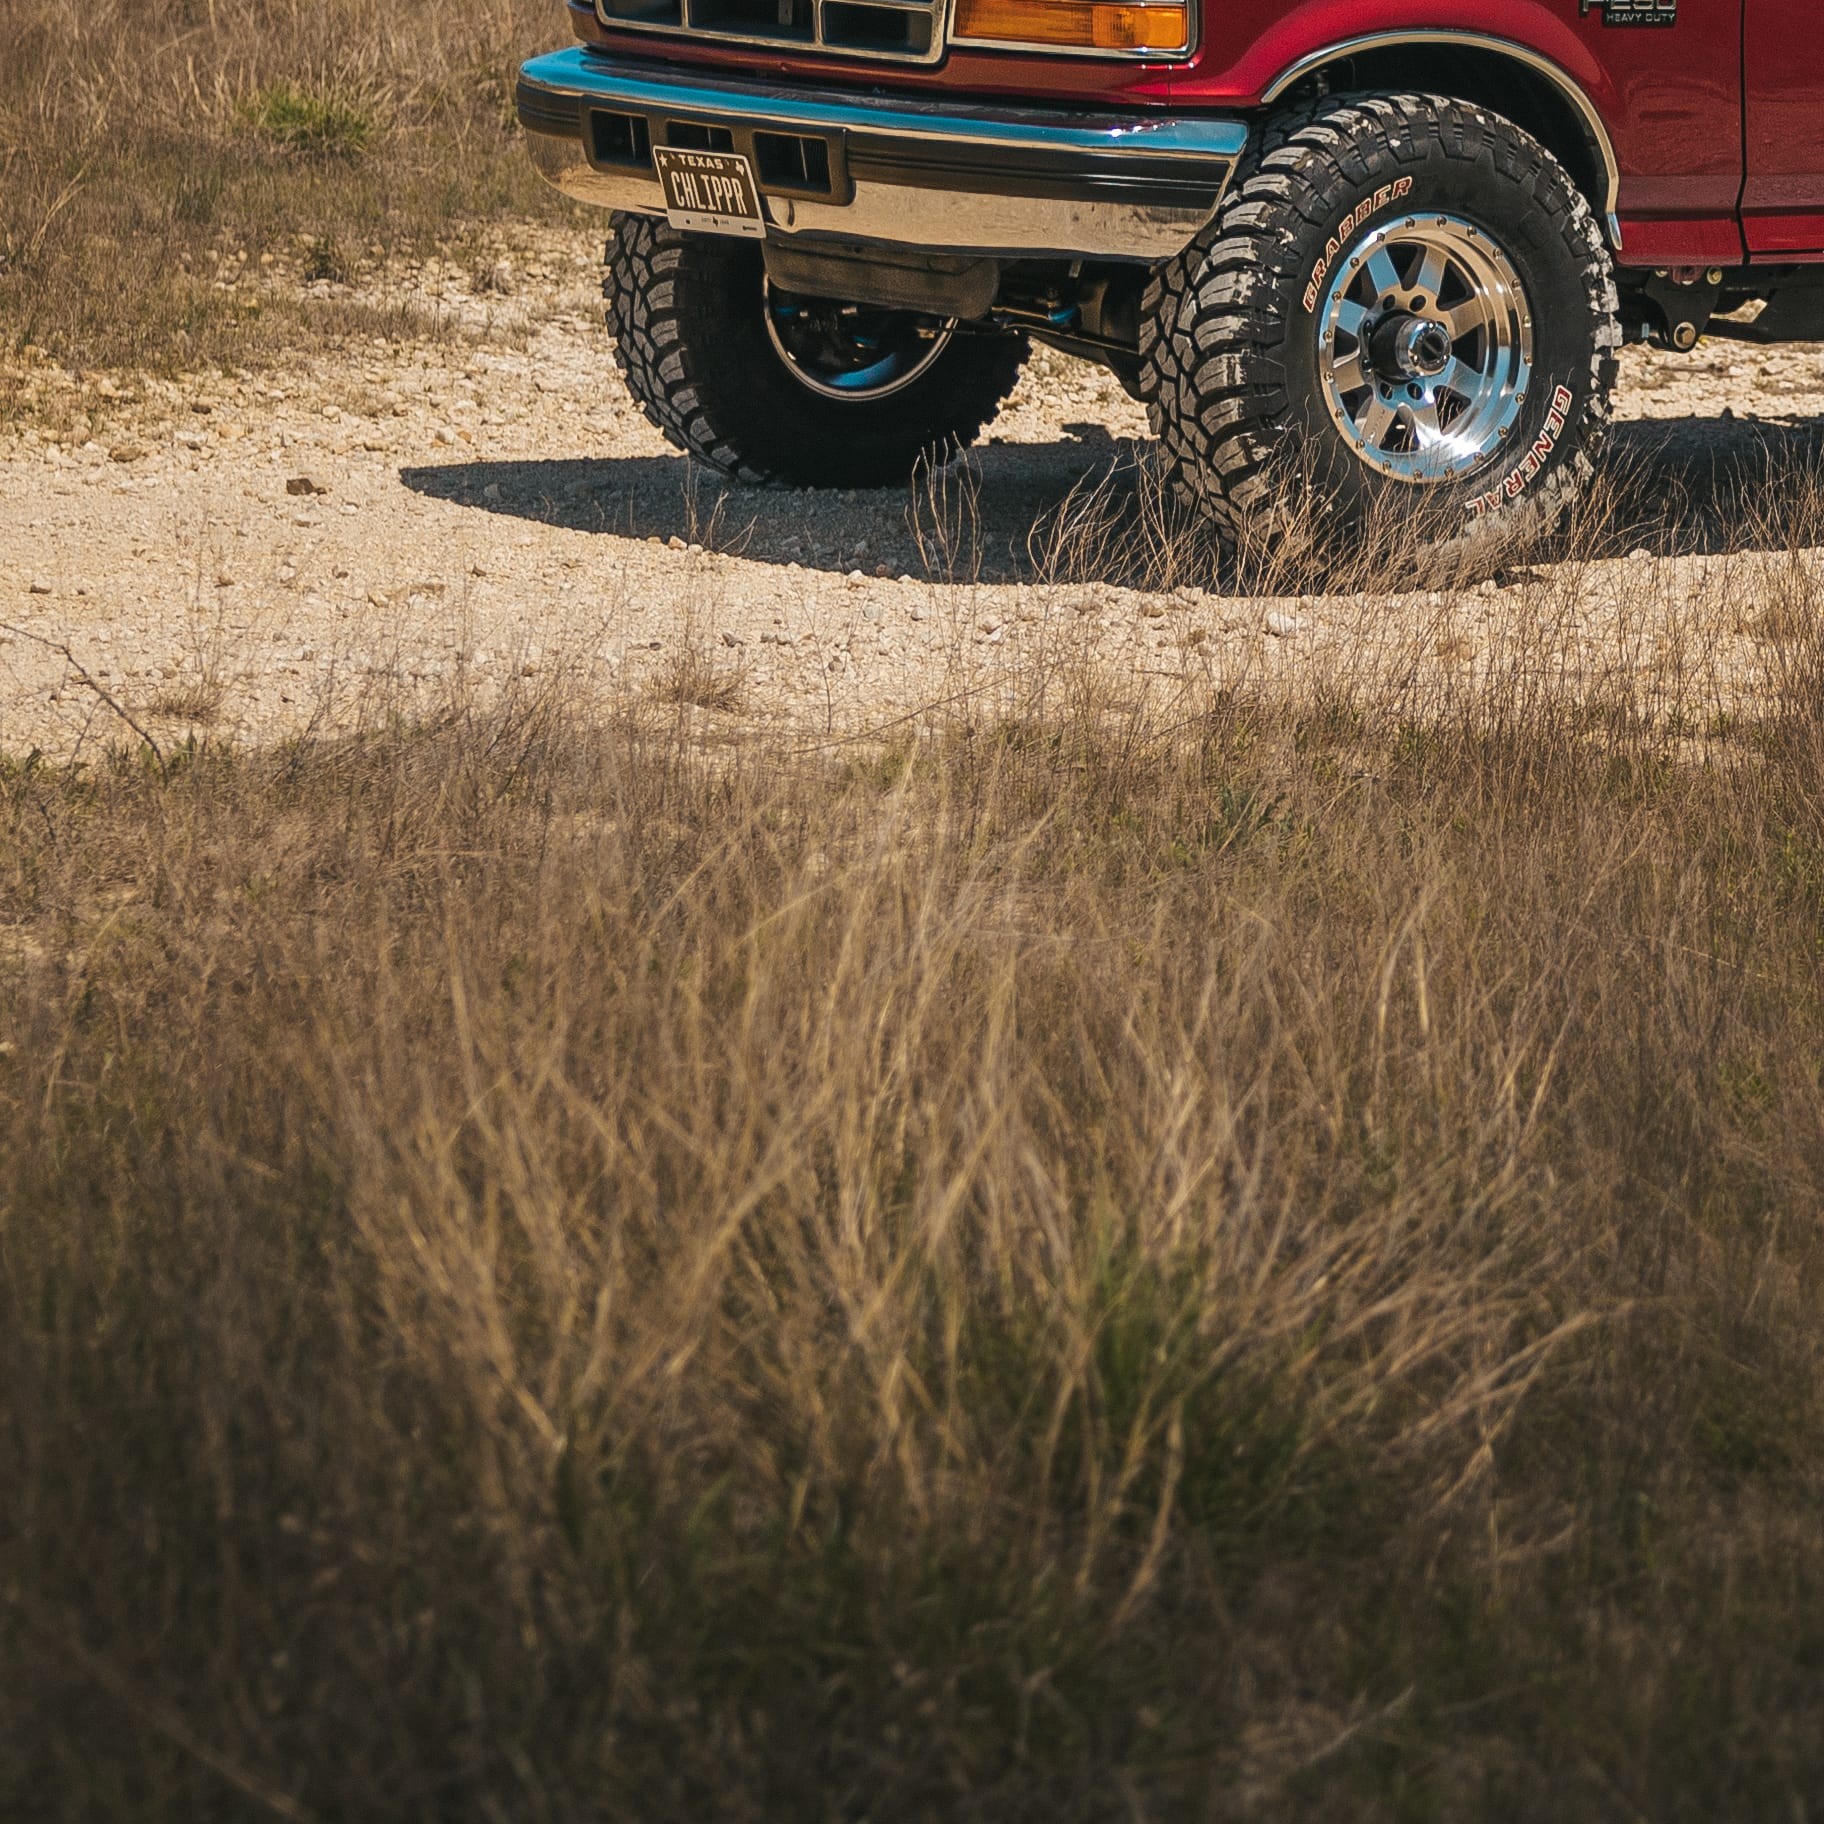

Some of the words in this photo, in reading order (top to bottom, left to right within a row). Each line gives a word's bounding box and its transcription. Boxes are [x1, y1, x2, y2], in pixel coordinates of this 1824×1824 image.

[1605, 13, 1642, 23] HEAVY
[1645, 13, 1675, 23] DUTY
[677, 154, 724, 170] TEXAS
[669, 170, 748, 216] CHLIPPR
[1302, 175, 1413, 314] GRABBER
[1464, 384, 1573, 517] GENERAL
